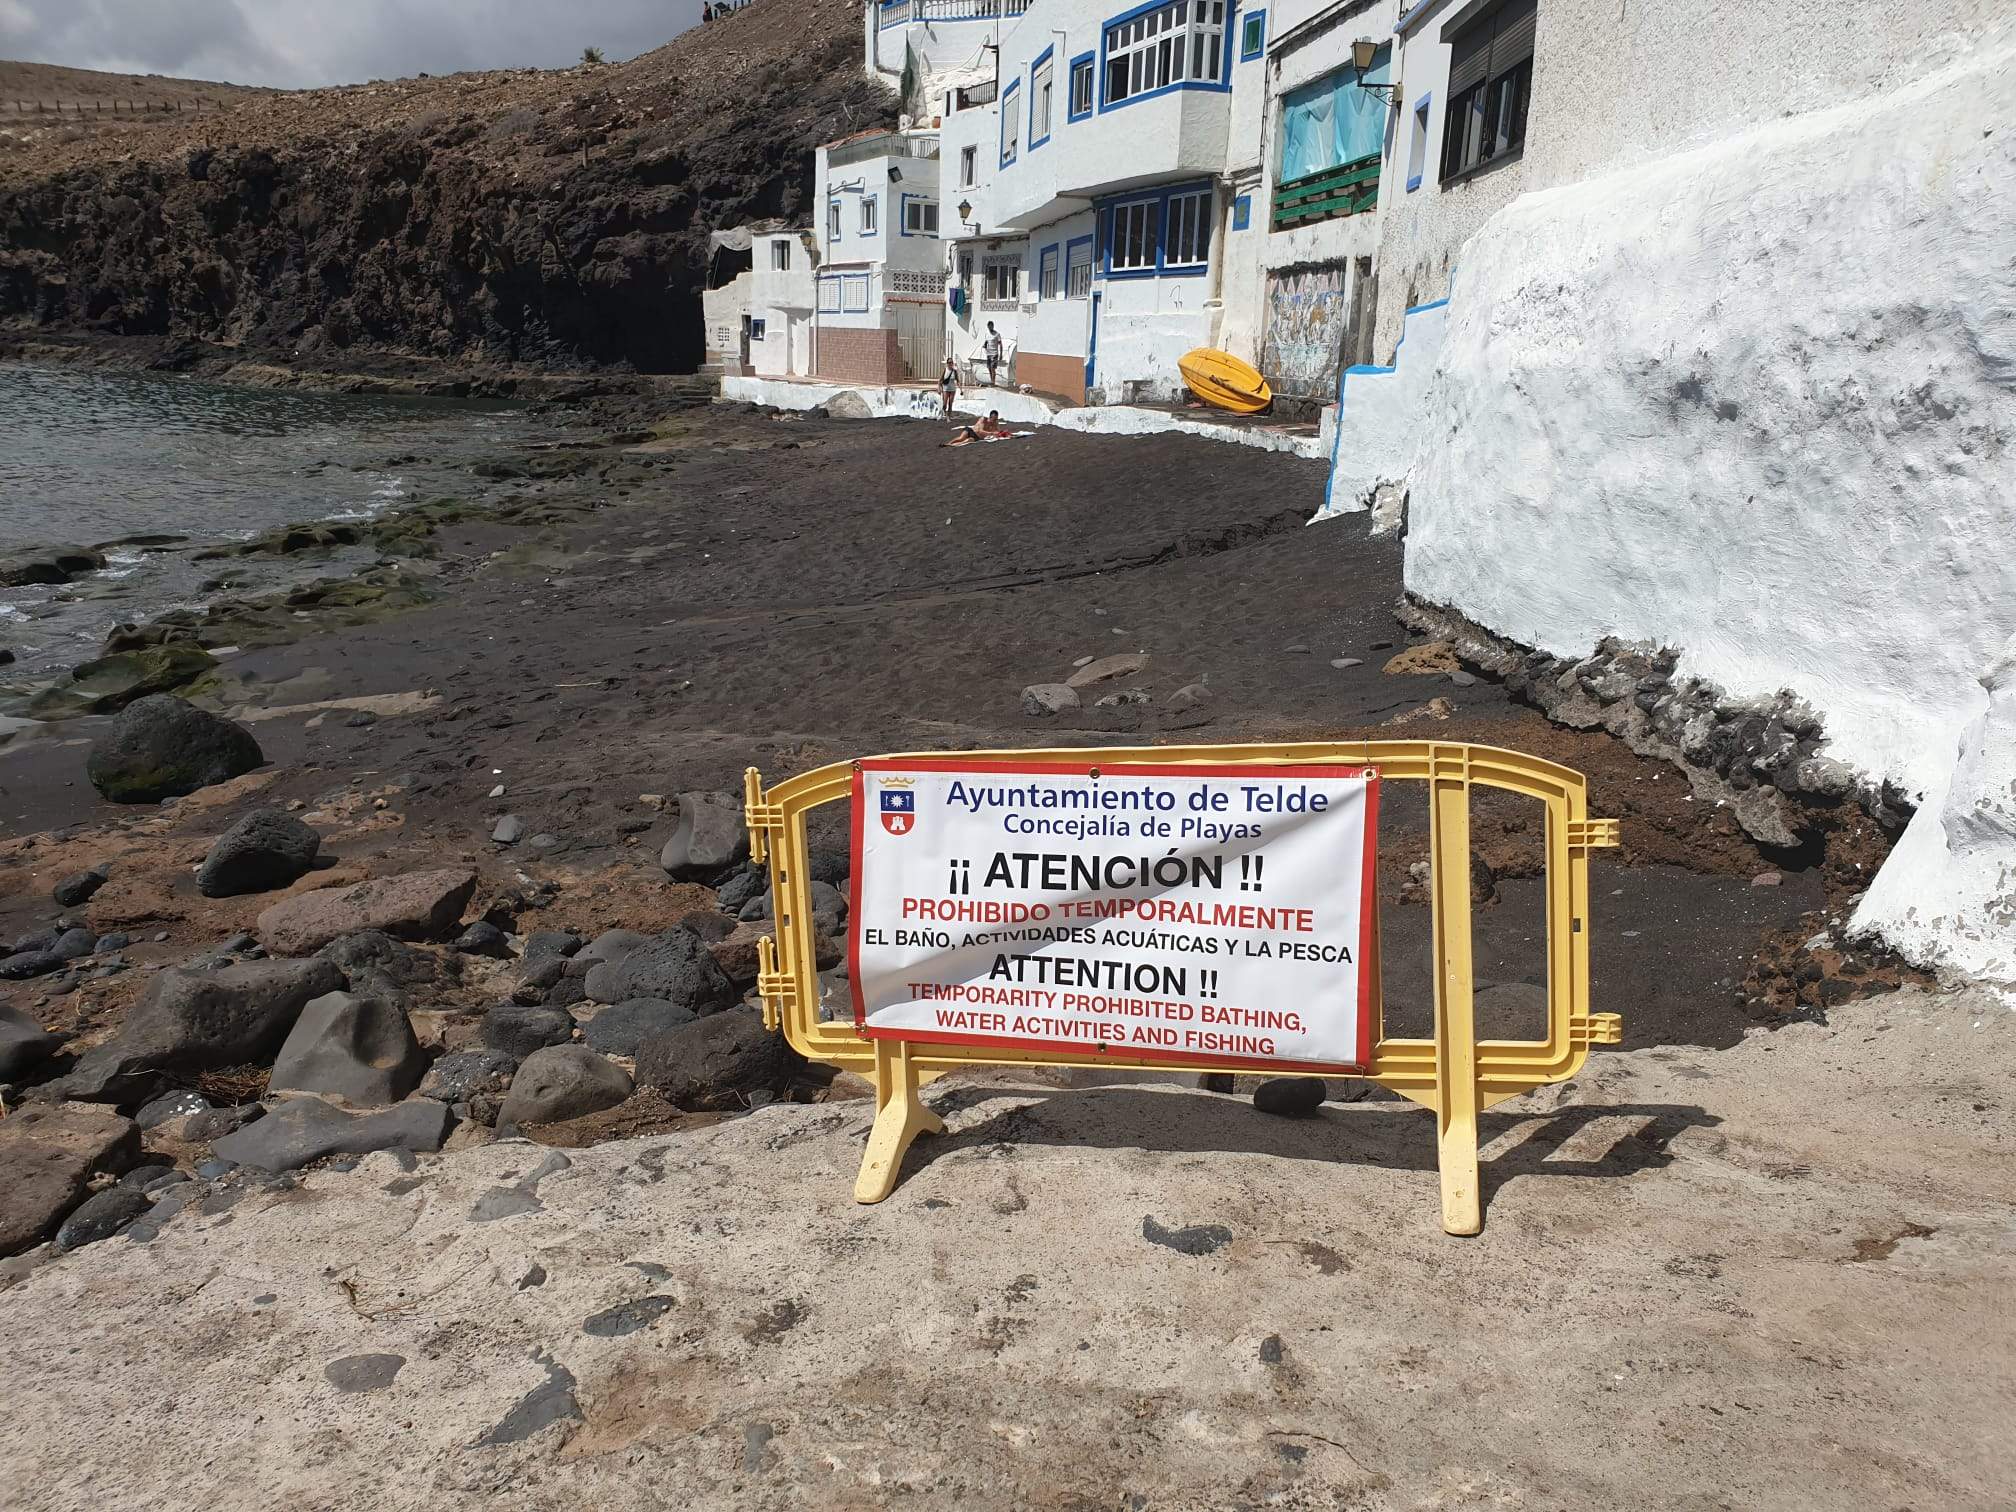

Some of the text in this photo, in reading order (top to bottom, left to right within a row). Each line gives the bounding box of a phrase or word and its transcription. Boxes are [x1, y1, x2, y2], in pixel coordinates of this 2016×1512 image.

[947, 781, 1329, 813] Ayuntamiento de Telde
[1004, 814, 1262, 843] Concejalía de Playas
[984, 847, 1222, 890] ATENCIÓN
[1239, 854, 1263, 892] !!
[903, 898, 1313, 932] PROHIBIDO TEMPORALMENTE
[866, 927, 1352, 963] EL BAÑO, ACTIVIDADES ACUÁTICAS Y LA PESCA
[989, 953, 1217, 998] ATTENTION !!
[908, 983, 1306, 1034] TEMPORARITY PROHIBITED BATHING,
[936, 1010, 1274, 1055] WATER ACTIVITIES AND FISHING
